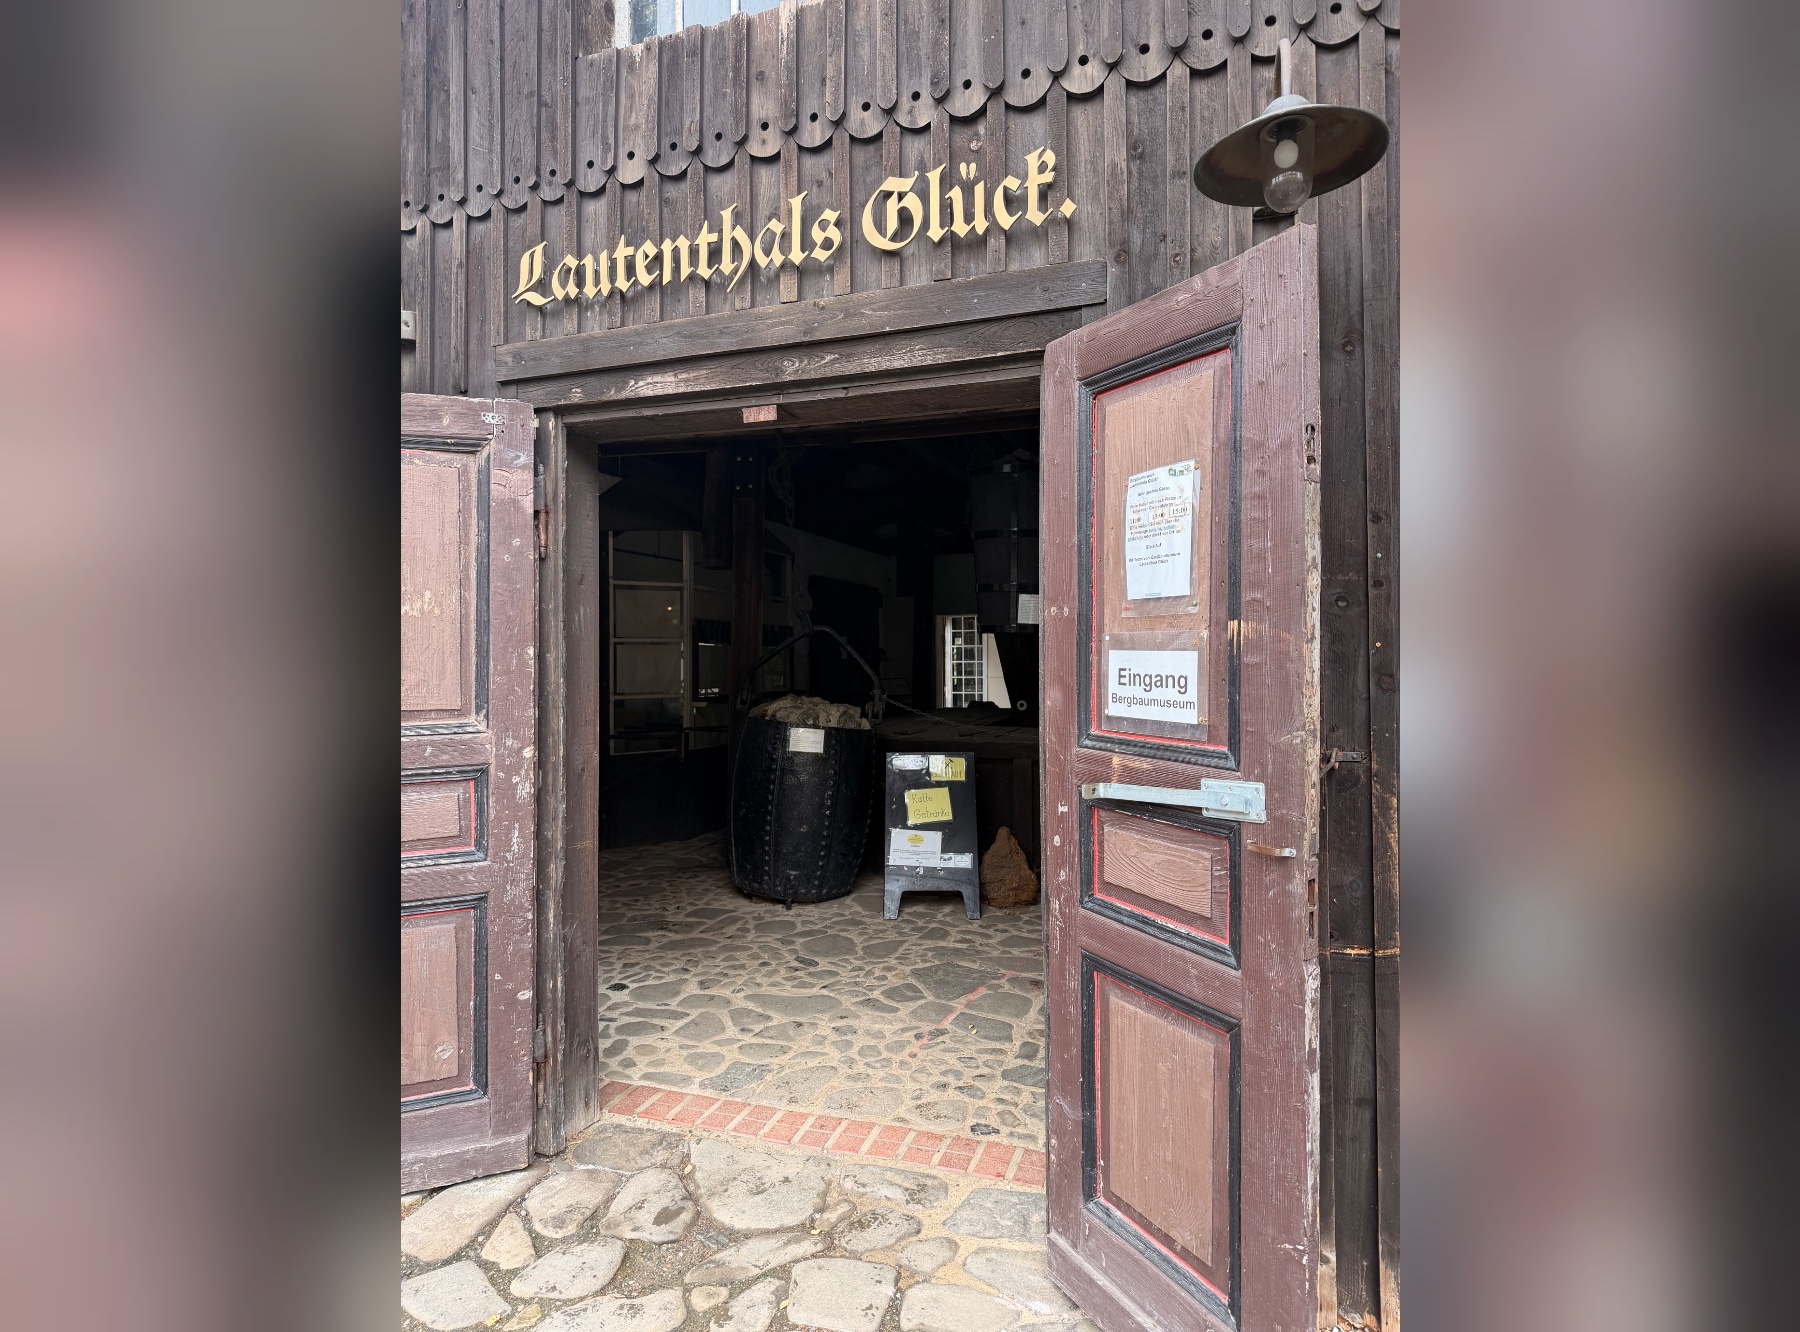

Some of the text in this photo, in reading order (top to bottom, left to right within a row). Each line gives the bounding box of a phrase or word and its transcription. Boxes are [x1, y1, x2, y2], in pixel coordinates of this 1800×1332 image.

[512, 146, 1077, 307] Lautenthals Glück.
[1172, 506, 1188, 515] 15:00
[1118, 667, 1188, 695] Eingang
[1111, 692, 1196, 710] Bergbaumuseum
[911, 792, 933, 804] Kalte
